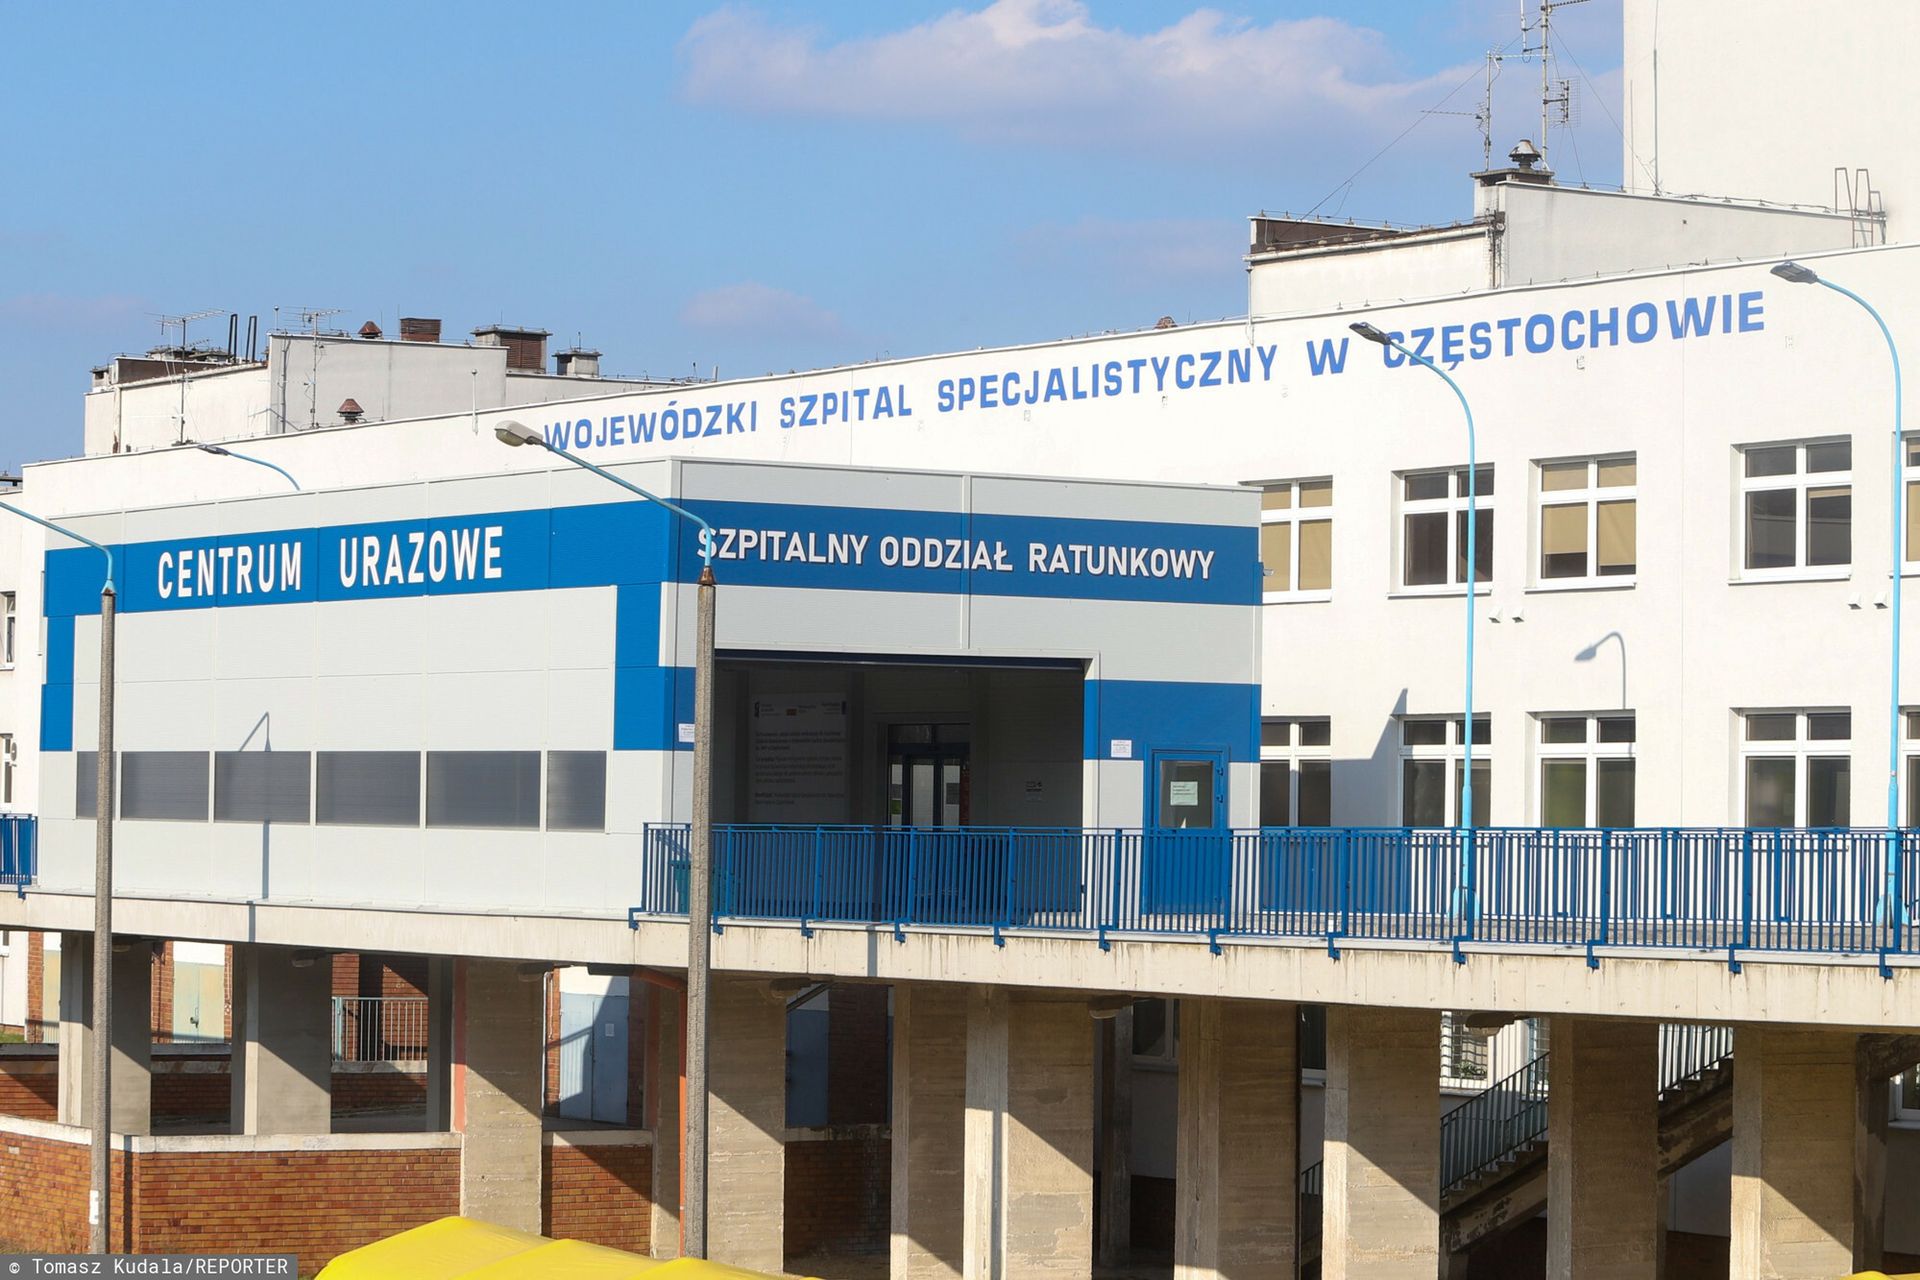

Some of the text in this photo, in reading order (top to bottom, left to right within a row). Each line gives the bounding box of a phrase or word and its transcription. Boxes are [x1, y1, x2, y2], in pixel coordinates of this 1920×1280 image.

[544, 291, 1764, 452] WOJEWÓDZKI SZPITAL SPECJALISTYCZNY W CZĘSTOCHOWIE
[157, 525, 504, 599] CENTRUM URAZOWE
[697, 527, 1215, 579] SZPITALNY ODDZIAŁ RATUNKOWY
